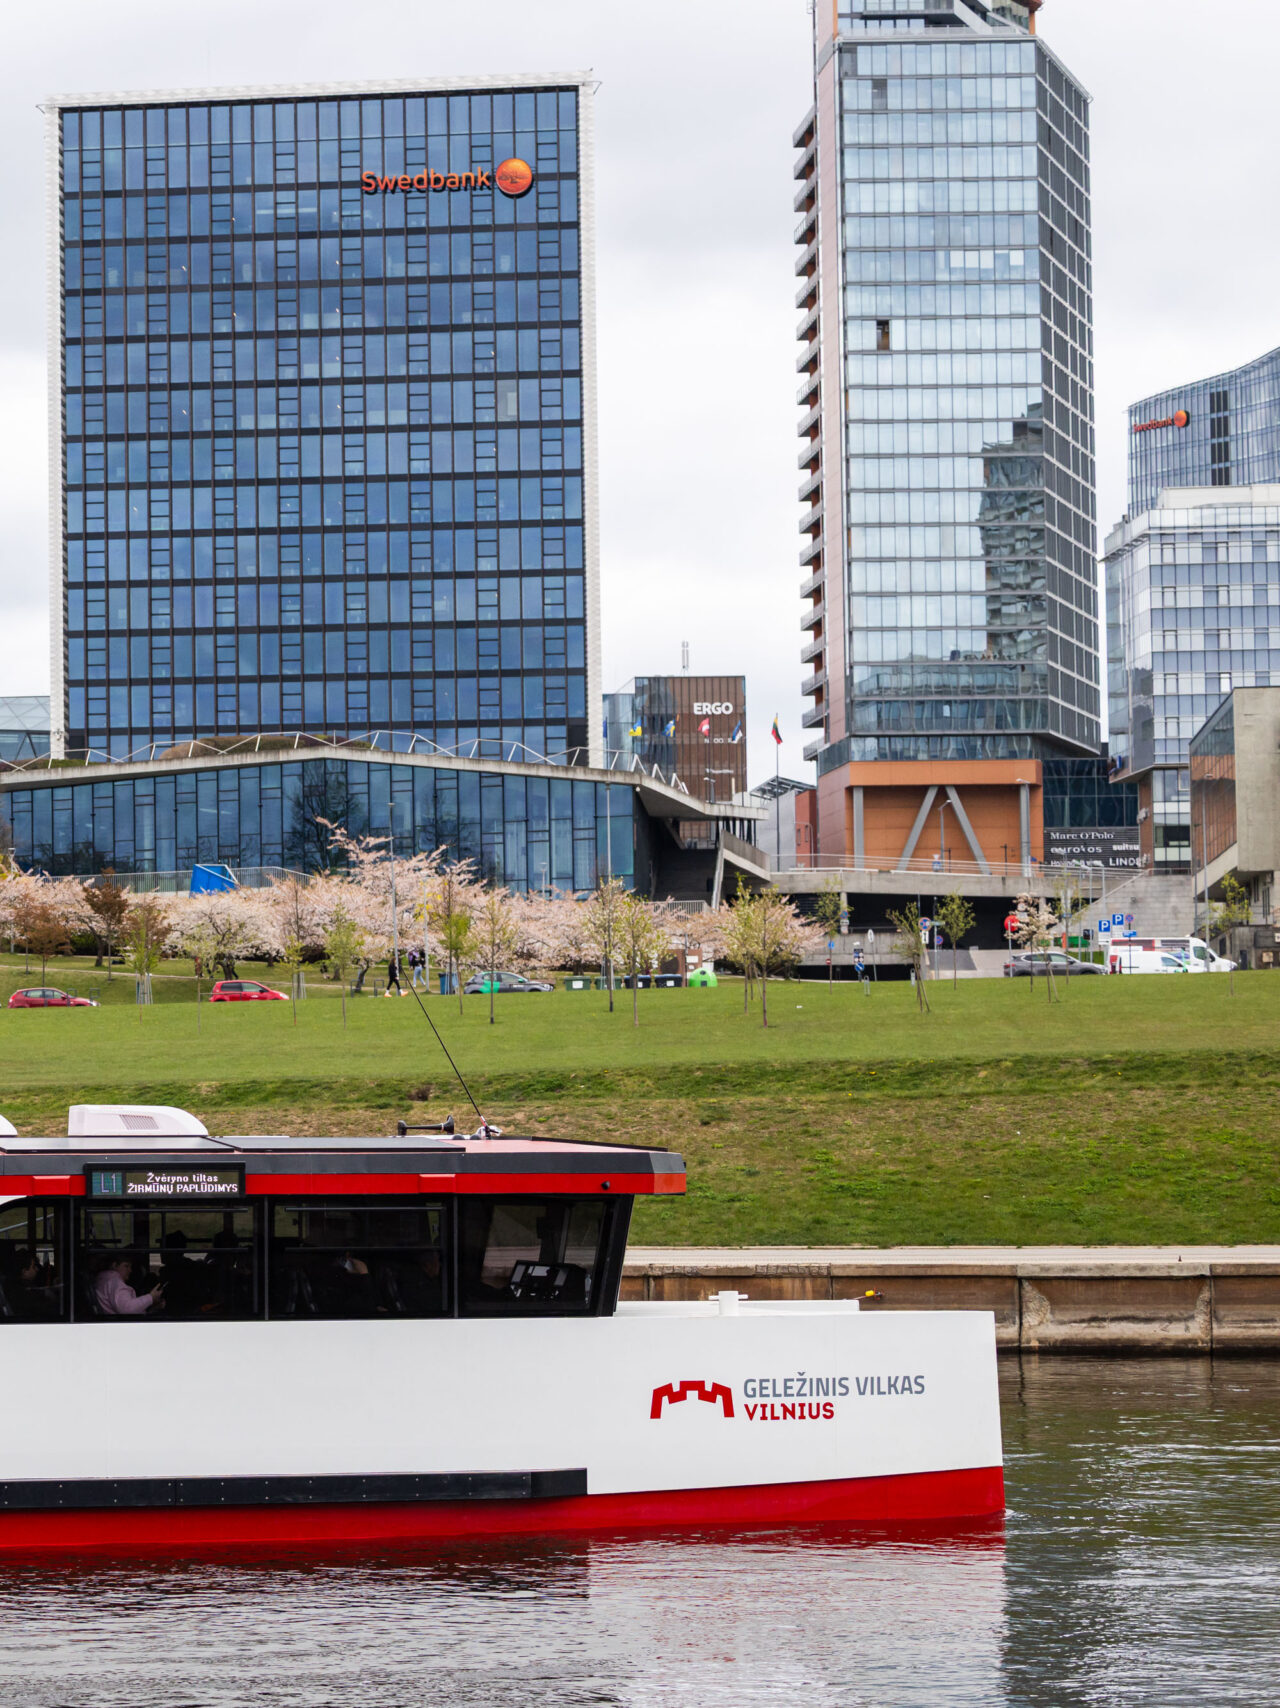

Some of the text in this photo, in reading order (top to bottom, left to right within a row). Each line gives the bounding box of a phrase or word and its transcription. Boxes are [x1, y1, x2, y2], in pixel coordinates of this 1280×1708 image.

[361, 165, 491, 193] Swedbank
[694, 702, 733, 715] ERGO
[1050, 832, 1078, 840] Marc
[101, 1173, 116, 1193] L1
[147, 1172, 218, 1183] Žvėryno tiltas
[176, 1183, 238, 1193] PAPLŪDIMYS
[743, 1371, 925, 1398] GELEŽINIS VILKAS
[744, 1402, 835, 1421] VILNIUS
